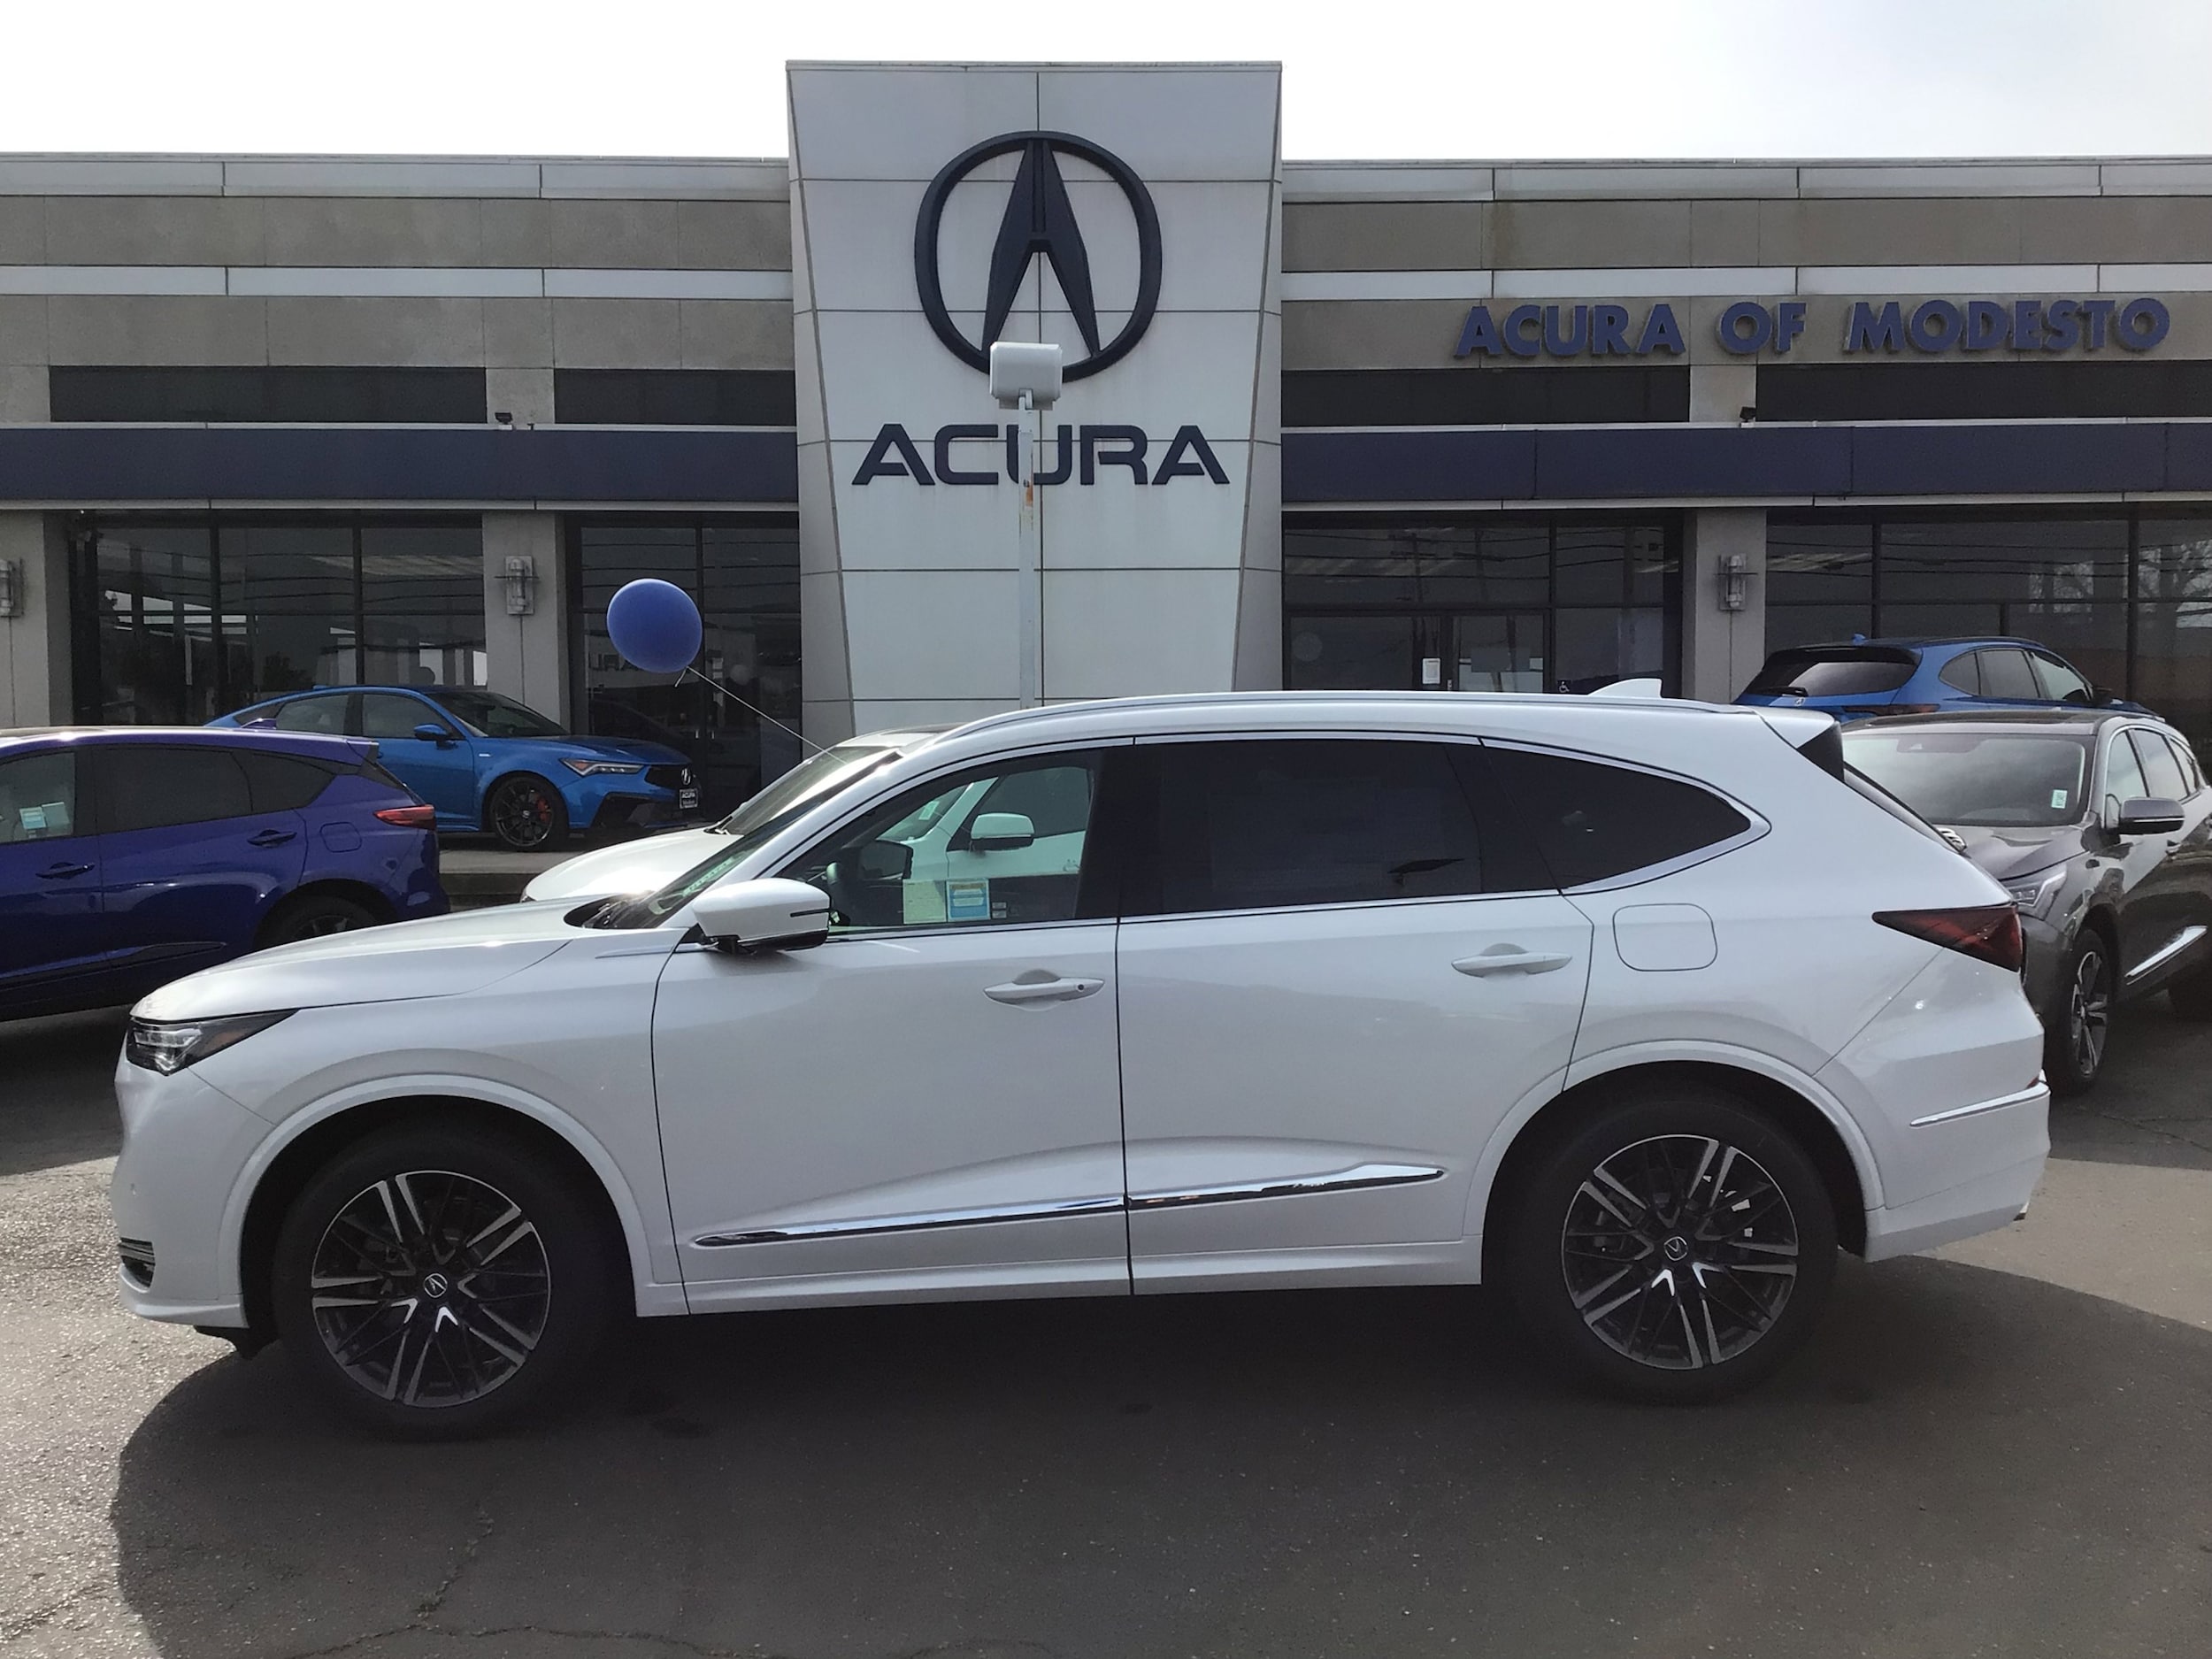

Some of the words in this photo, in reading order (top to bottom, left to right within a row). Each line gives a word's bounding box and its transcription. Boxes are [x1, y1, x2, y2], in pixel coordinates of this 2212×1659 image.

[1455, 303, 1686, 355] ACURA
[1717, 301, 1807, 354] OF
[1846, 297, 2171, 353] MODESTO
[851, 423, 1231, 486] ACURA
